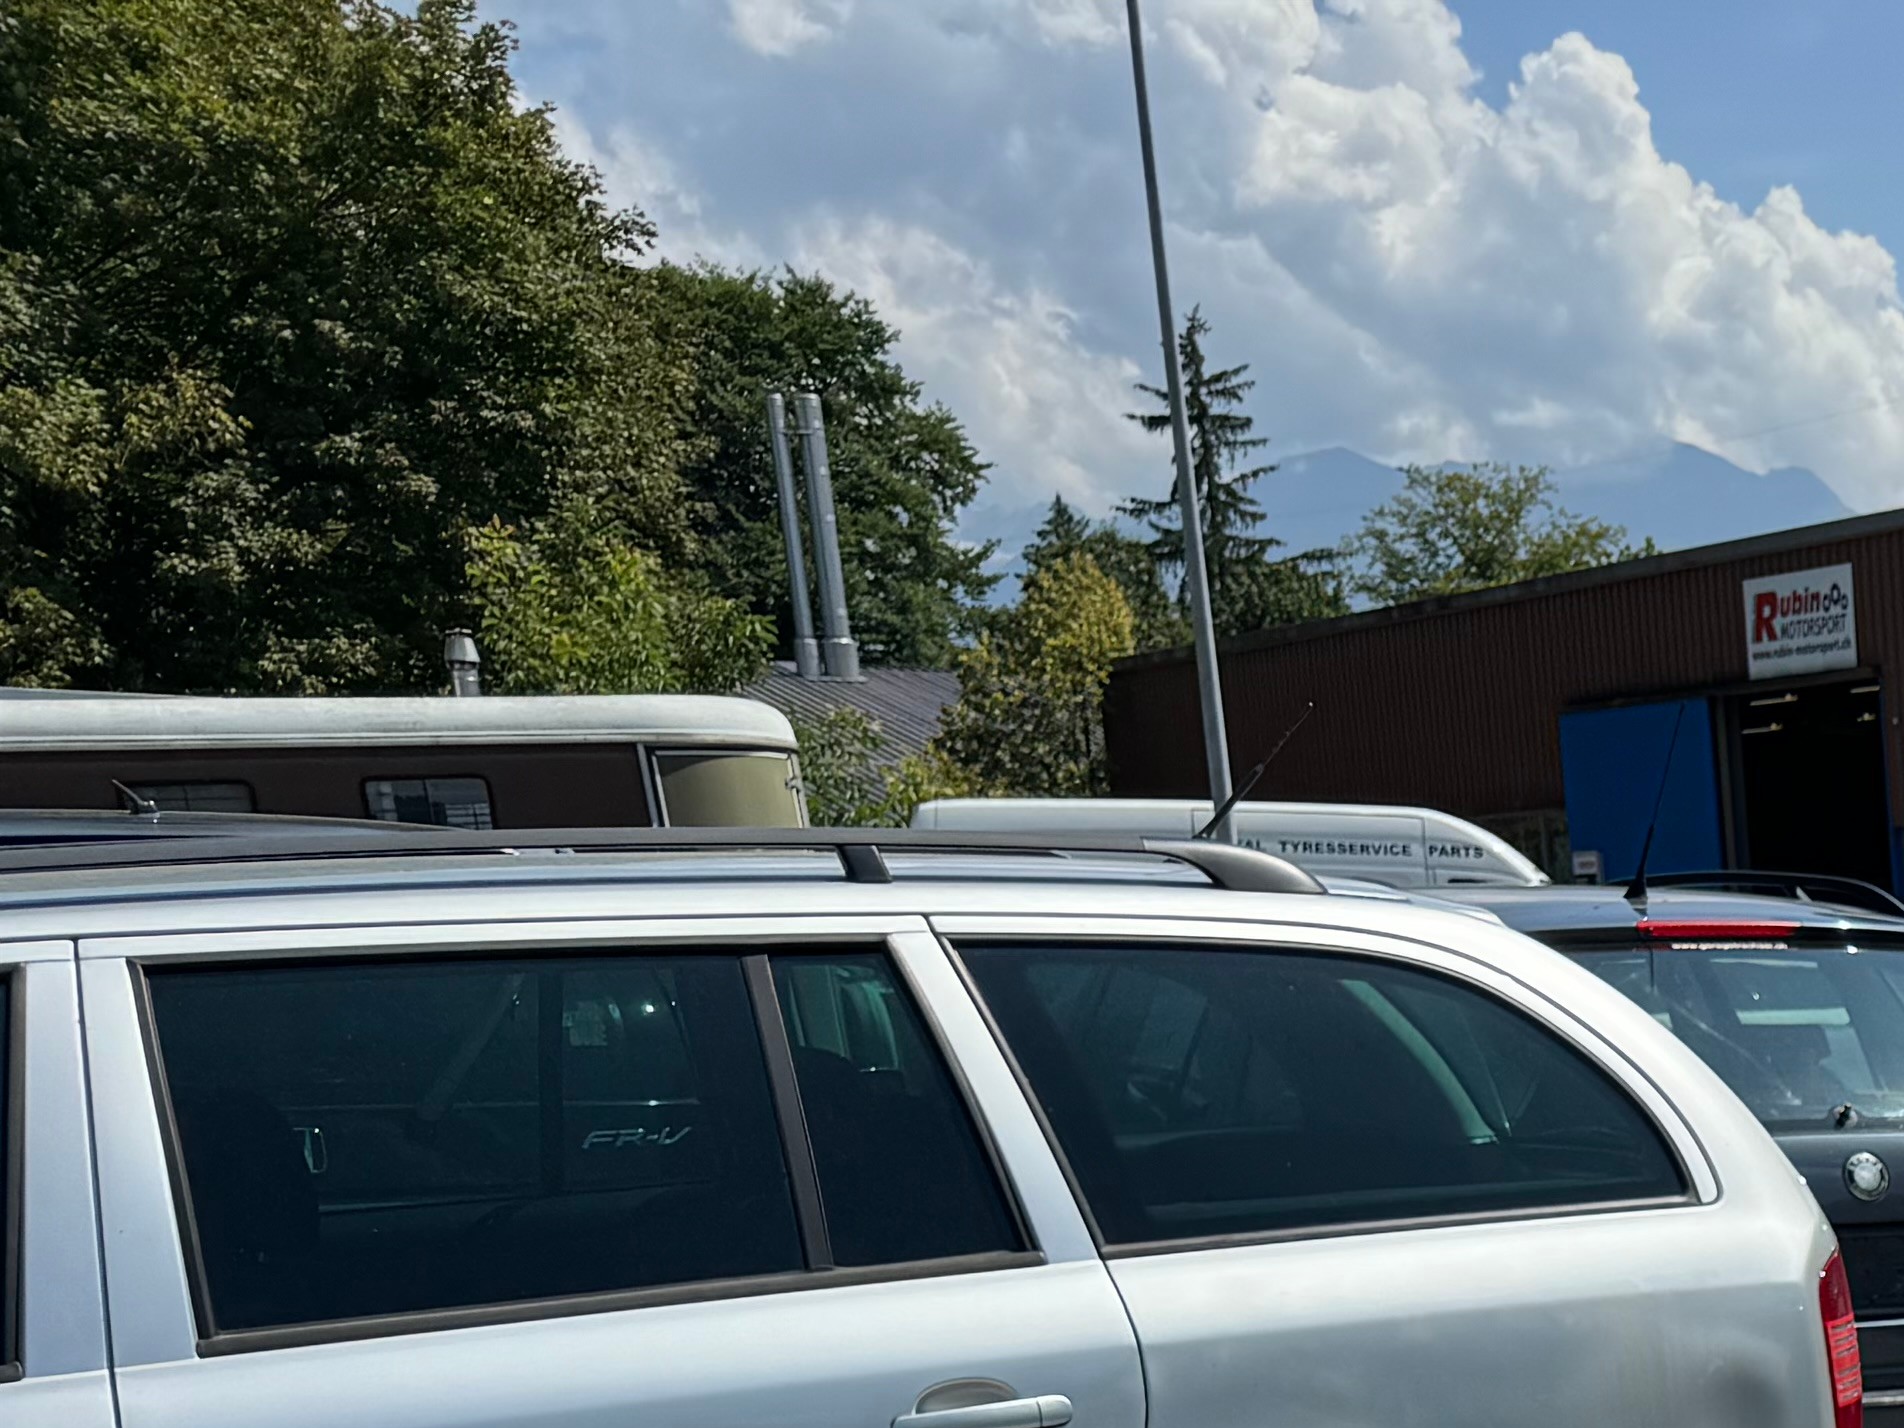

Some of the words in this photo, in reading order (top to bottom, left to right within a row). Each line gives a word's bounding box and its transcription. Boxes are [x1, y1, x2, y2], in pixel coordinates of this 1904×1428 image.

[1754, 587, 1822, 644] Rubin
[1278, 839, 1413, 857] TYRESSERVICE
[1428, 843, 1485, 859] PARTS
